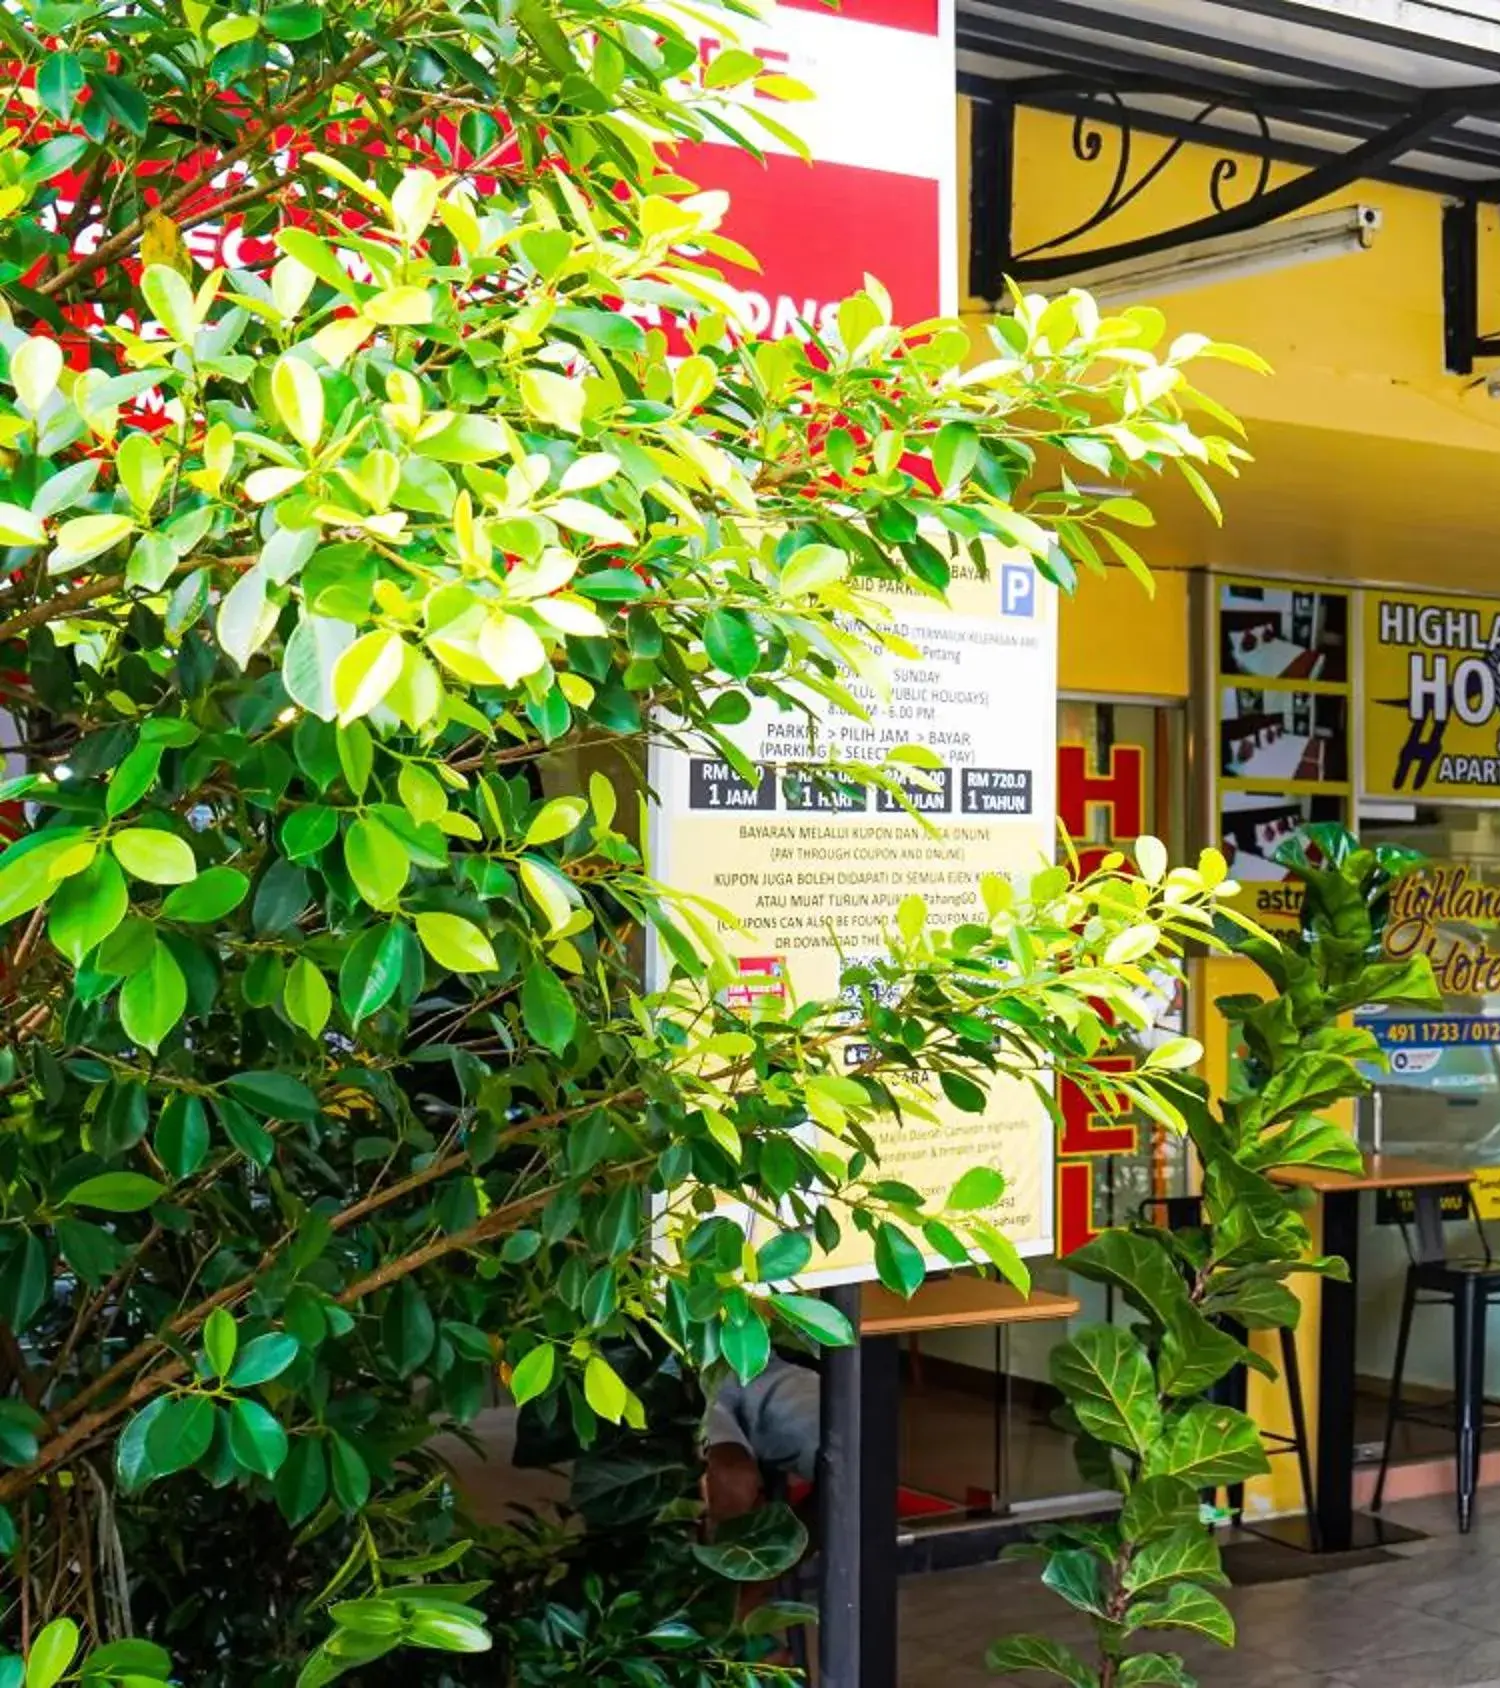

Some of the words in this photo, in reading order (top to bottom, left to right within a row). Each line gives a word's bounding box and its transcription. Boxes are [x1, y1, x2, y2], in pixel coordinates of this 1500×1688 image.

[893, 669, 940, 683] SUNDAY
[840, 726, 875, 742] PILIH
[879, 729, 909, 743] JAM
[929, 731, 972, 746] BAYAR
[703, 763, 728, 780] RM
[967, 771, 989, 787] RM
[992, 772, 1026, 789] 720.0
[709, 783, 720, 805] 1
[725, 788, 758, 806] JAM
[802, 785, 813, 807] 1
[901, 792, 945, 809] ULAN
[968, 790, 977, 810] 1
[982, 795, 1026, 811] TAHUN
[739, 825, 795, 839] BAYARAN
[799, 825, 848, 840] MELALUI
[852, 827, 892, 841] KUPON
[895, 828, 919, 840] DAN
[797, 847, 850, 860] THROUGH
[853, 848, 897, 861] COUPON
[901, 849, 923, 860] AND
[714, 873, 759, 887] KUPON
[762, 873, 793, 886] JUGA
[797, 873, 834, 886] BOLEH
[837, 872, 889, 886] DIDAPATI
[906, 871, 945, 885] SEMUA
[756, 895, 787, 908] ATAU
[790, 895, 824, 908] MUAT
[828, 894, 869, 907] TURUN
[1256, 885, 1304, 911] astr
[780, 917, 803, 929] CAN
[806, 916, 834, 929] ALSO
[836, 915, 849, 927] BE
[852, 914, 889, 927] FOUND
[1388, 1023, 1417, 1042] 491
[1422, 1022, 1460, 1041] 1733
[1471, 1021, 1500, 1041] 012
